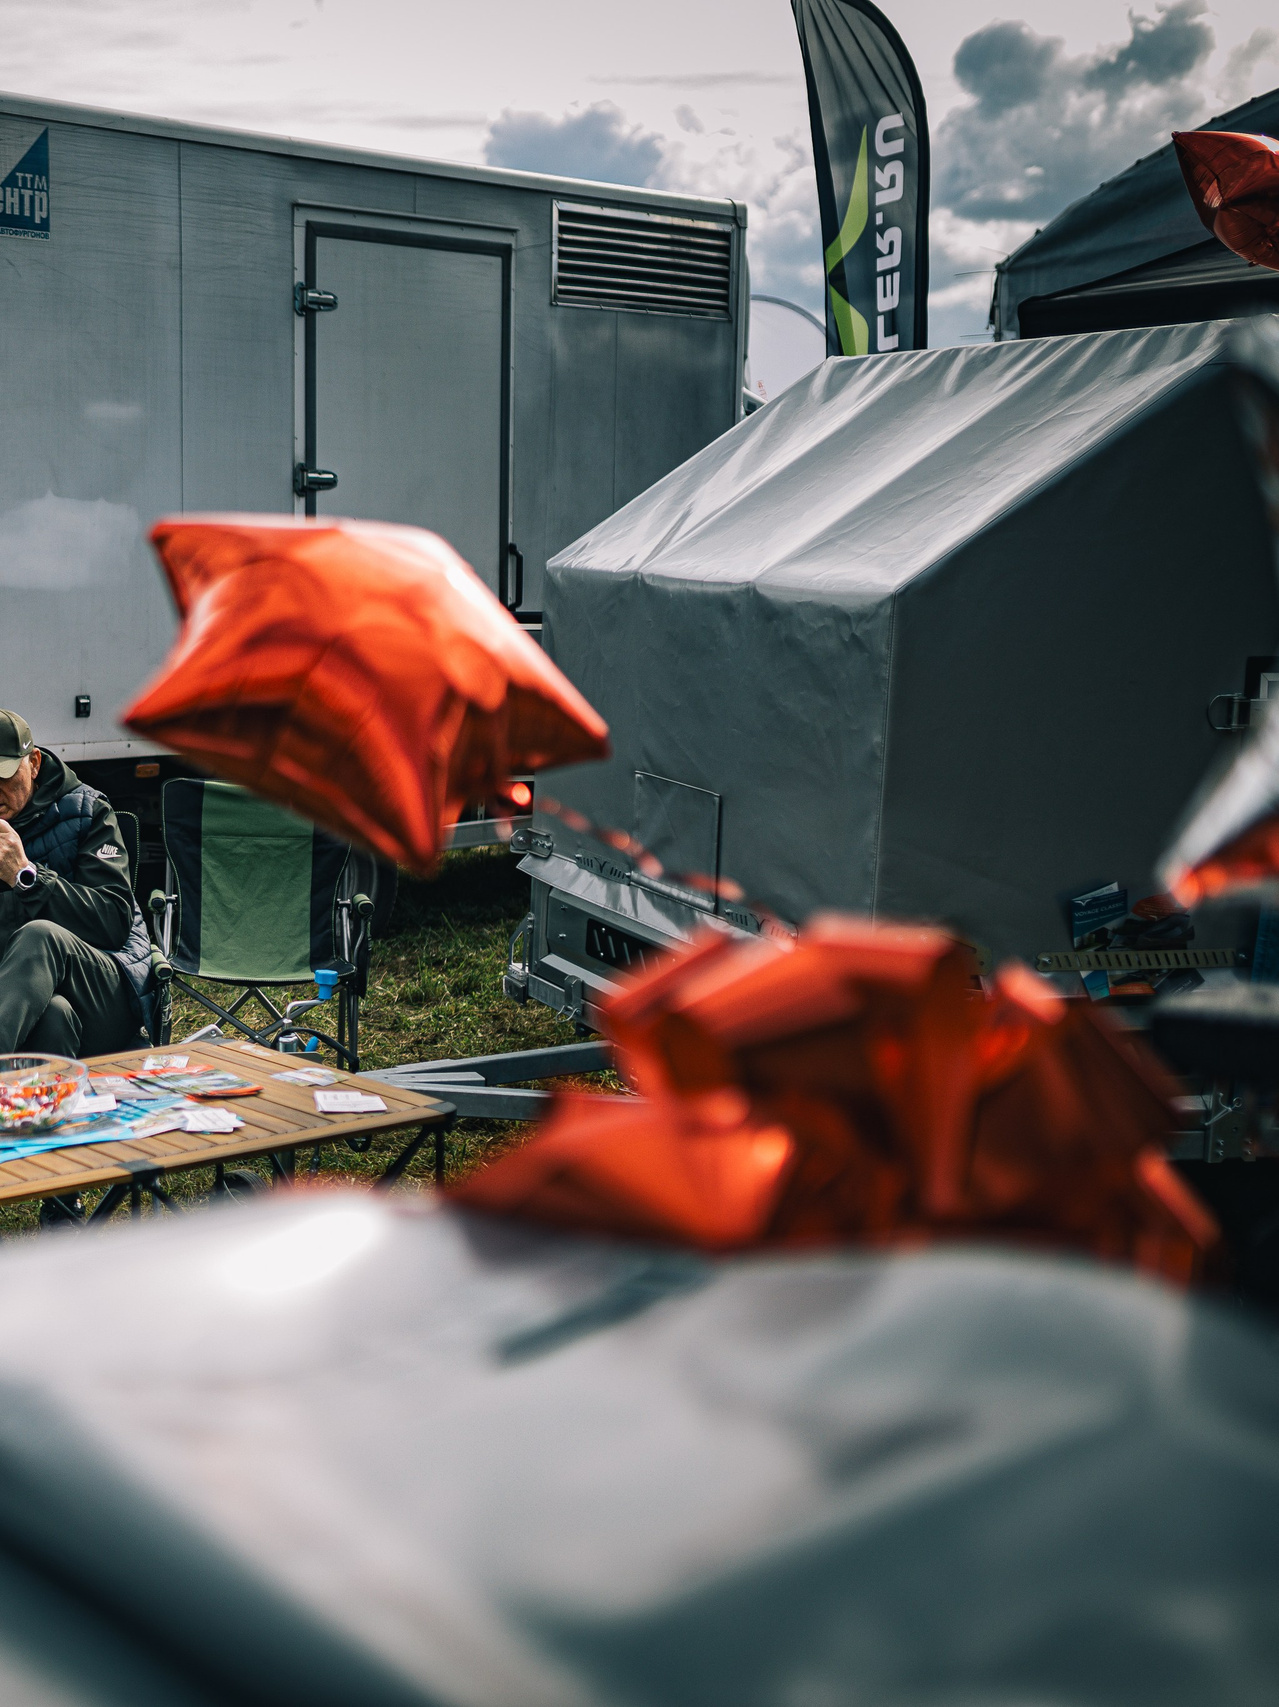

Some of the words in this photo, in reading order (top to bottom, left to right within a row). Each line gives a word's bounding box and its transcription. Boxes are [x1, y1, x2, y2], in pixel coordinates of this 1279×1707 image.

[15, 172, 48, 190] ТТМ
[101, 843, 119, 856] NIKE
[1074, 907, 1100, 917] VOYAGE
